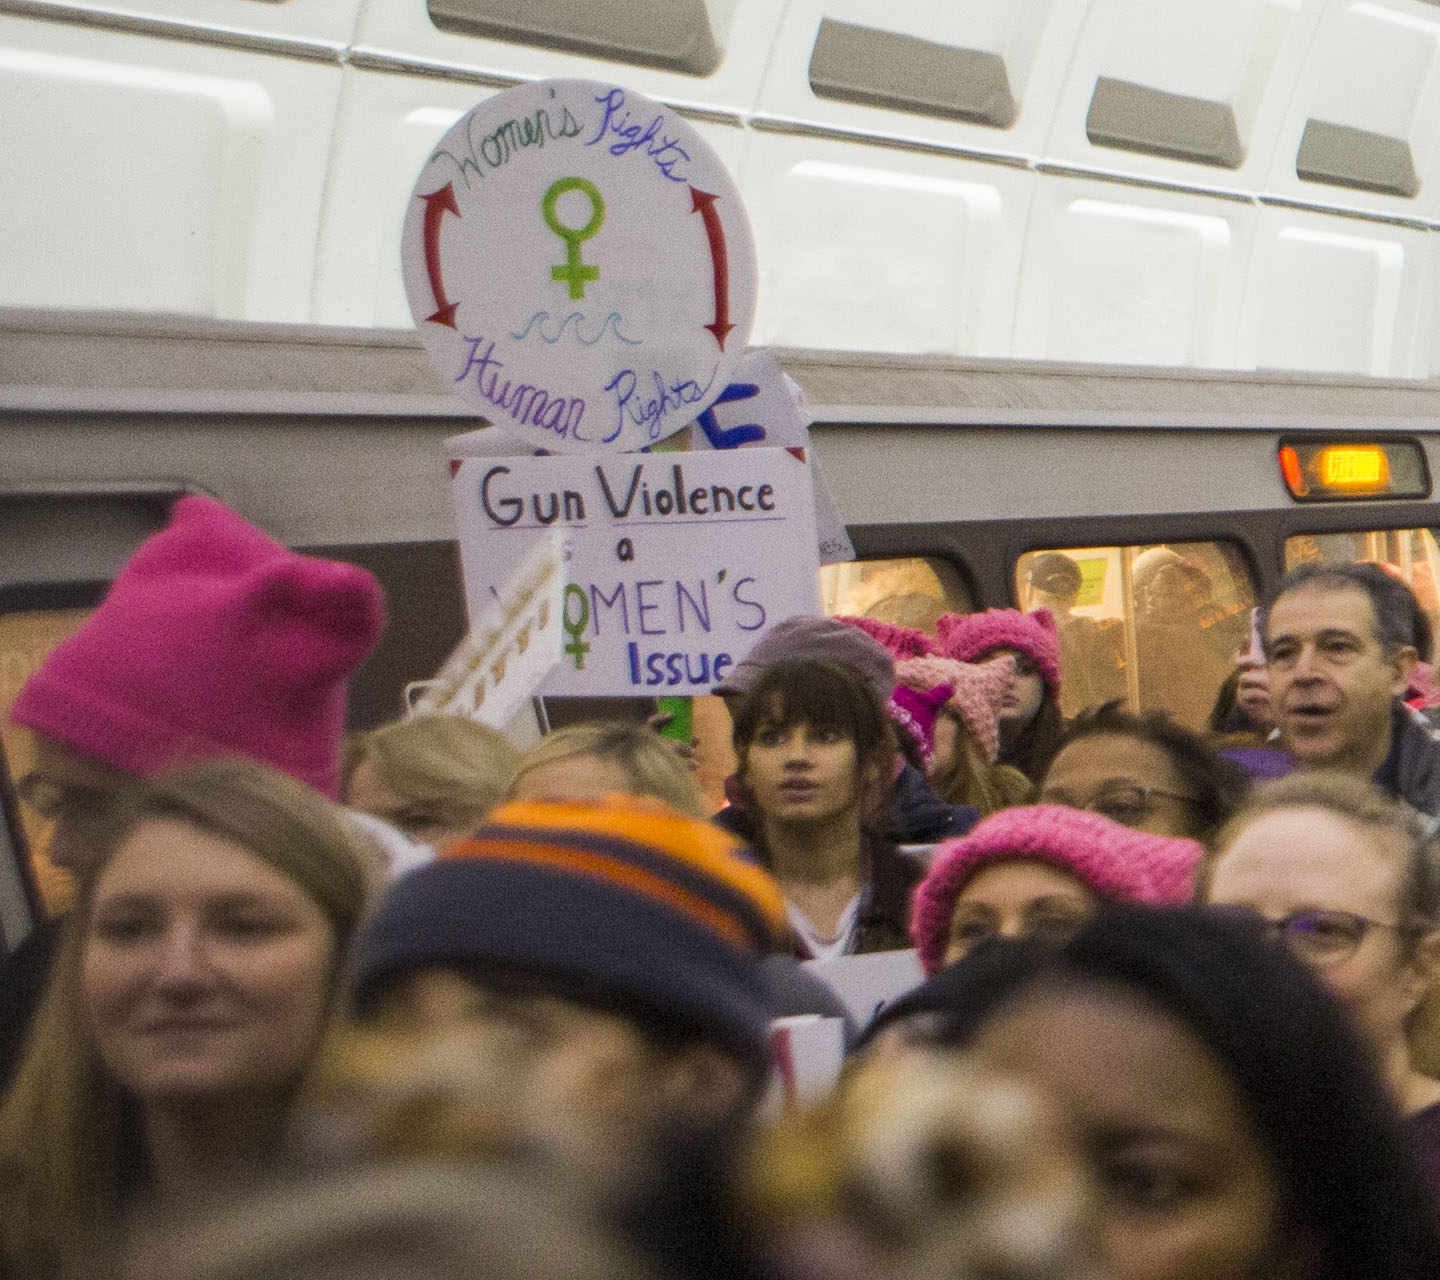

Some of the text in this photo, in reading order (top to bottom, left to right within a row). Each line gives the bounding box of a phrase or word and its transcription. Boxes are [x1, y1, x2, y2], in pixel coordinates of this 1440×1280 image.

[585, 88, 691, 183] Rights
[455, 334, 592, 442] Human
[601, 361, 720, 444] Rights
[481, 463, 776, 527] Gun Violence
[616, 535, 636, 563] a
[626, 640, 734, 687] Issue
